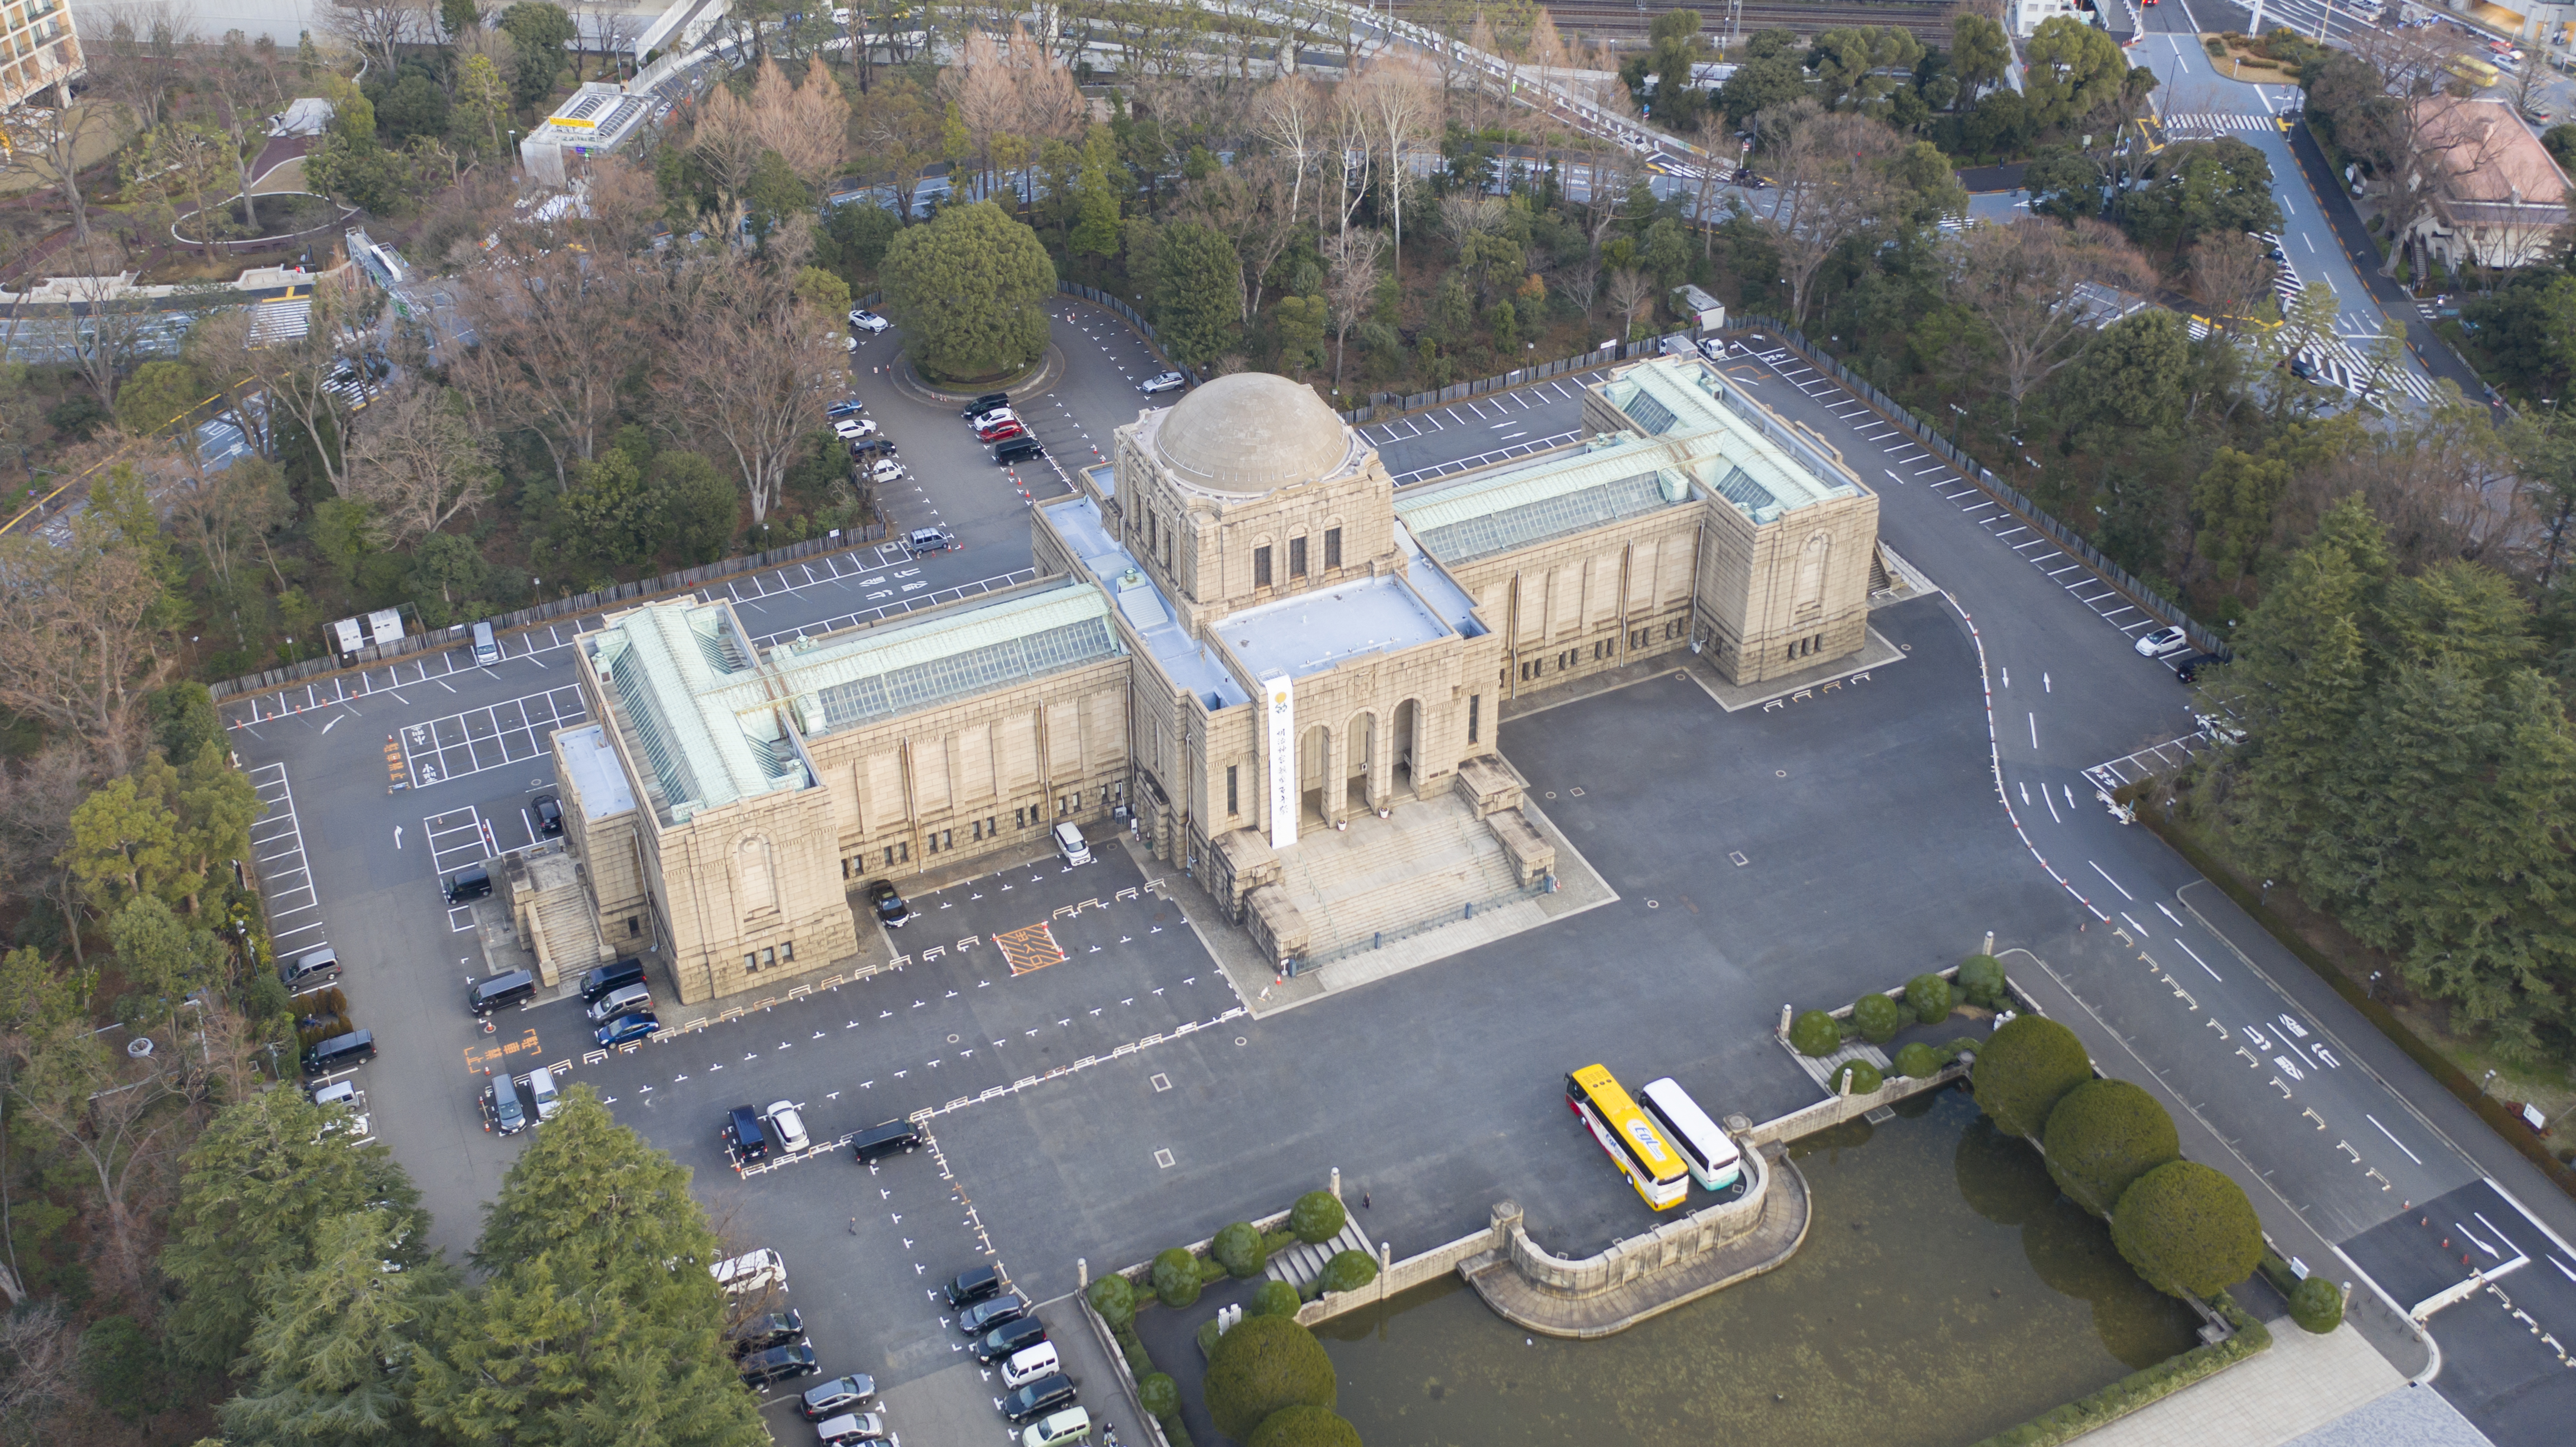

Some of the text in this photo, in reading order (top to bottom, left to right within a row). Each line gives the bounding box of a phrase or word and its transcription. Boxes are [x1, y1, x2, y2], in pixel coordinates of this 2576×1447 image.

[411, 725, 426, 746] 小型
[422, 763, 438, 784] 小型
[1016, 931, 1043, 966] 出入口
[466, 1035, 539, 1066] 駐車禁止
